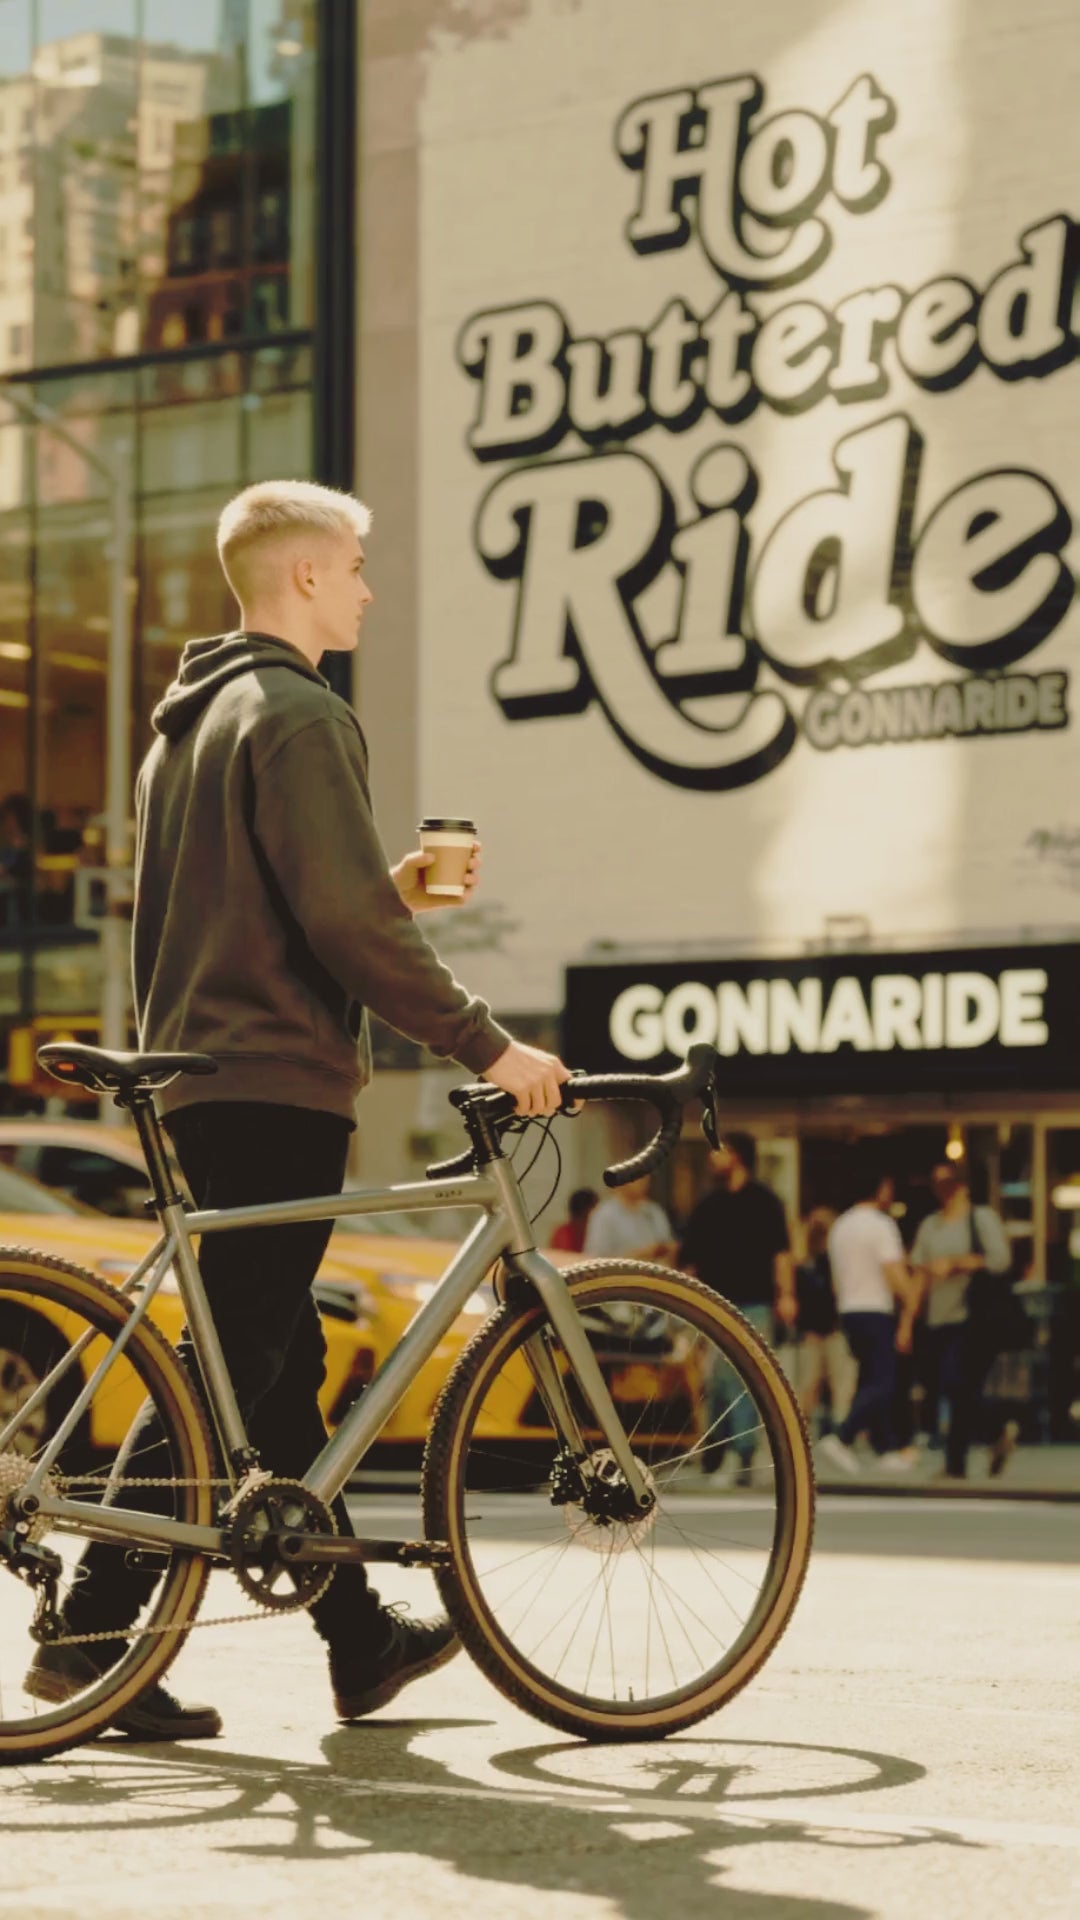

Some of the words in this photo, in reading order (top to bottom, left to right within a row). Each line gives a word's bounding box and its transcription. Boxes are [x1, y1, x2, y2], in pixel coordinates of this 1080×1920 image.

[615, 72, 897, 291] Hot
[456, 214, 1080, 461] Buttered
[474, 412, 1076, 792] Ride
[804, 672, 1068, 751] GONNARIDE
[609, 968, 1048, 1061] GONNARIDE
